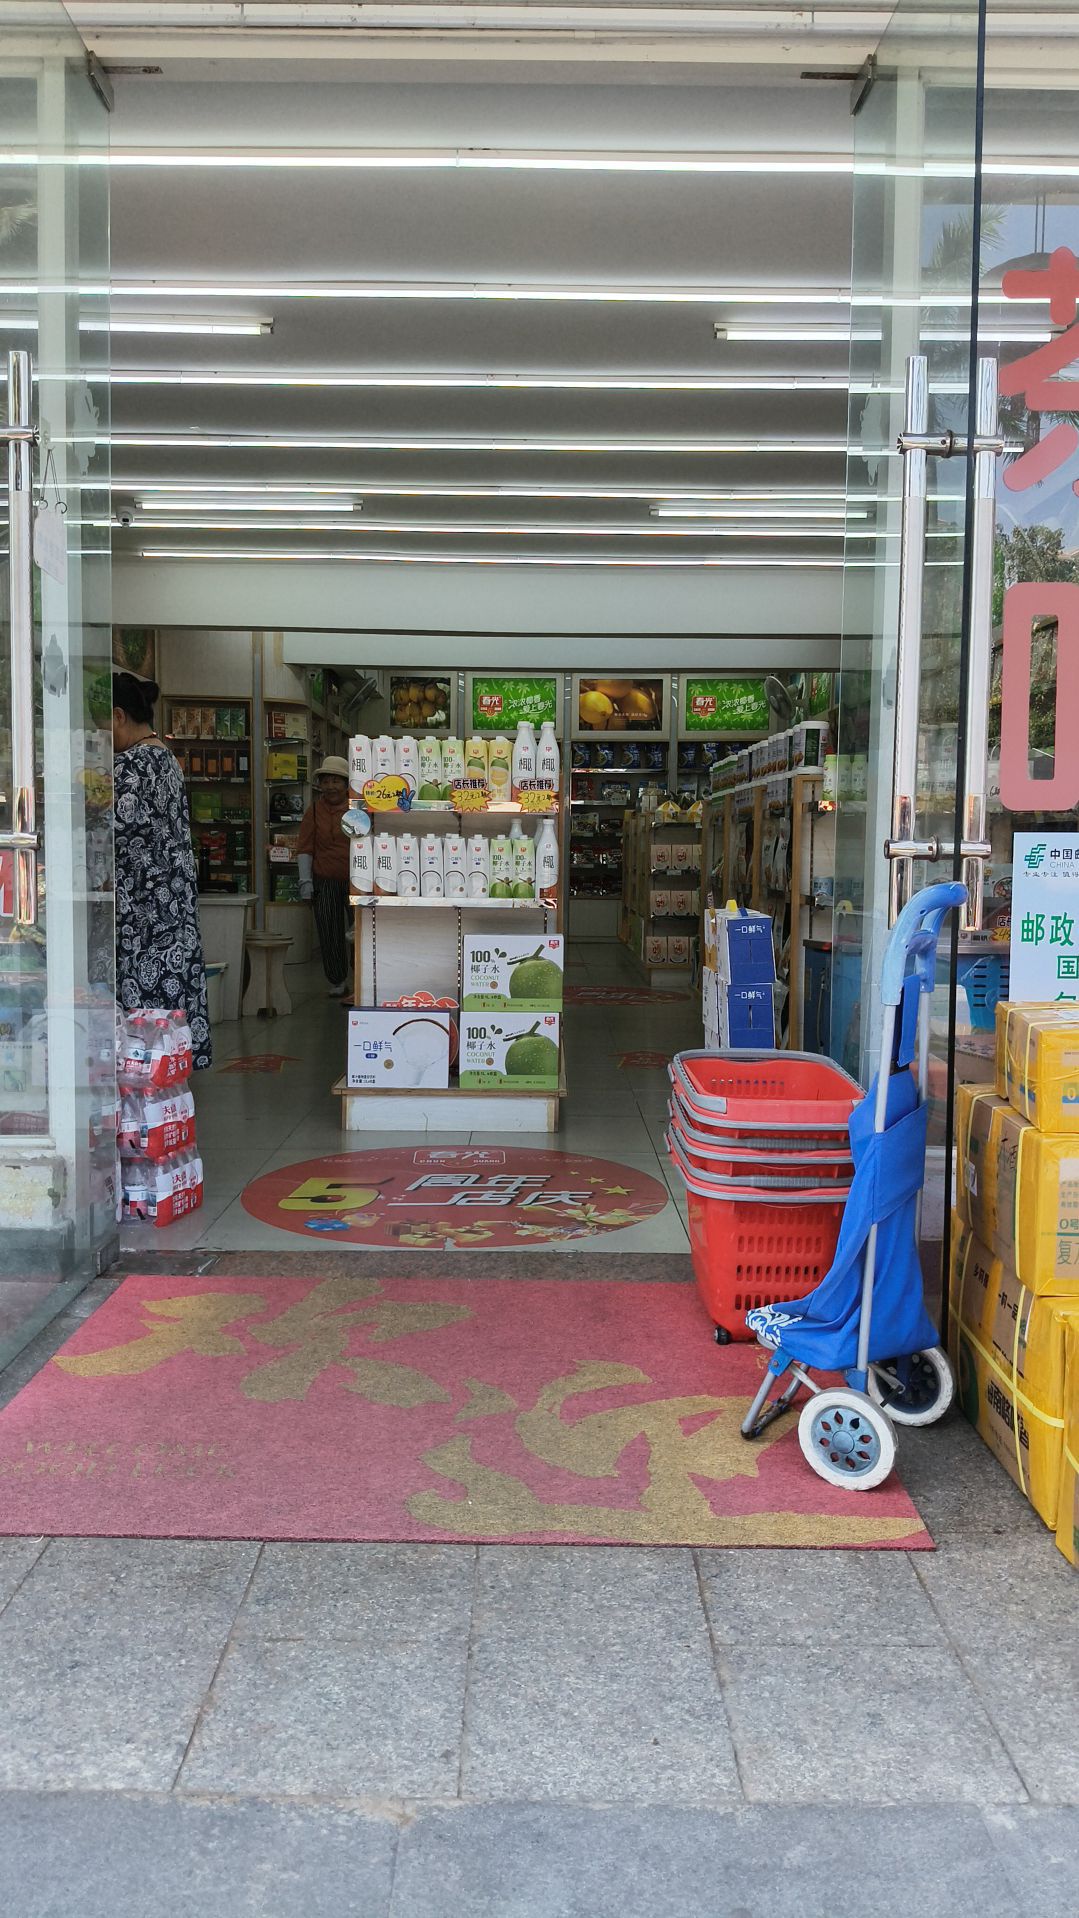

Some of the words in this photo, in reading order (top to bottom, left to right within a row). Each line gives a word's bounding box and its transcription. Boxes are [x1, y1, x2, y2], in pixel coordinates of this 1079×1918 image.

[519, 758, 532, 771] 椰
[542, 758, 555, 772] 椰
[455, 779, 485, 789] 店长推荐
[521, 780, 552, 790] 店长推荐
[353, 856, 368, 870] 椰
[377, 856, 392, 870] 椰
[735, 925, 763, 934] 一口鲜气
[1021, 912, 1074, 946] 邮政
[471, 964, 500, 974] 椰子水
[735, 991, 763, 999] 一口鲜气
[354, 1040, 392, 1053] 一口鲜气
[467, 1041, 496, 1050] 椰子水
[405, 1174, 551, 1191] 周年
[278, 1177, 395, 1211] 5
